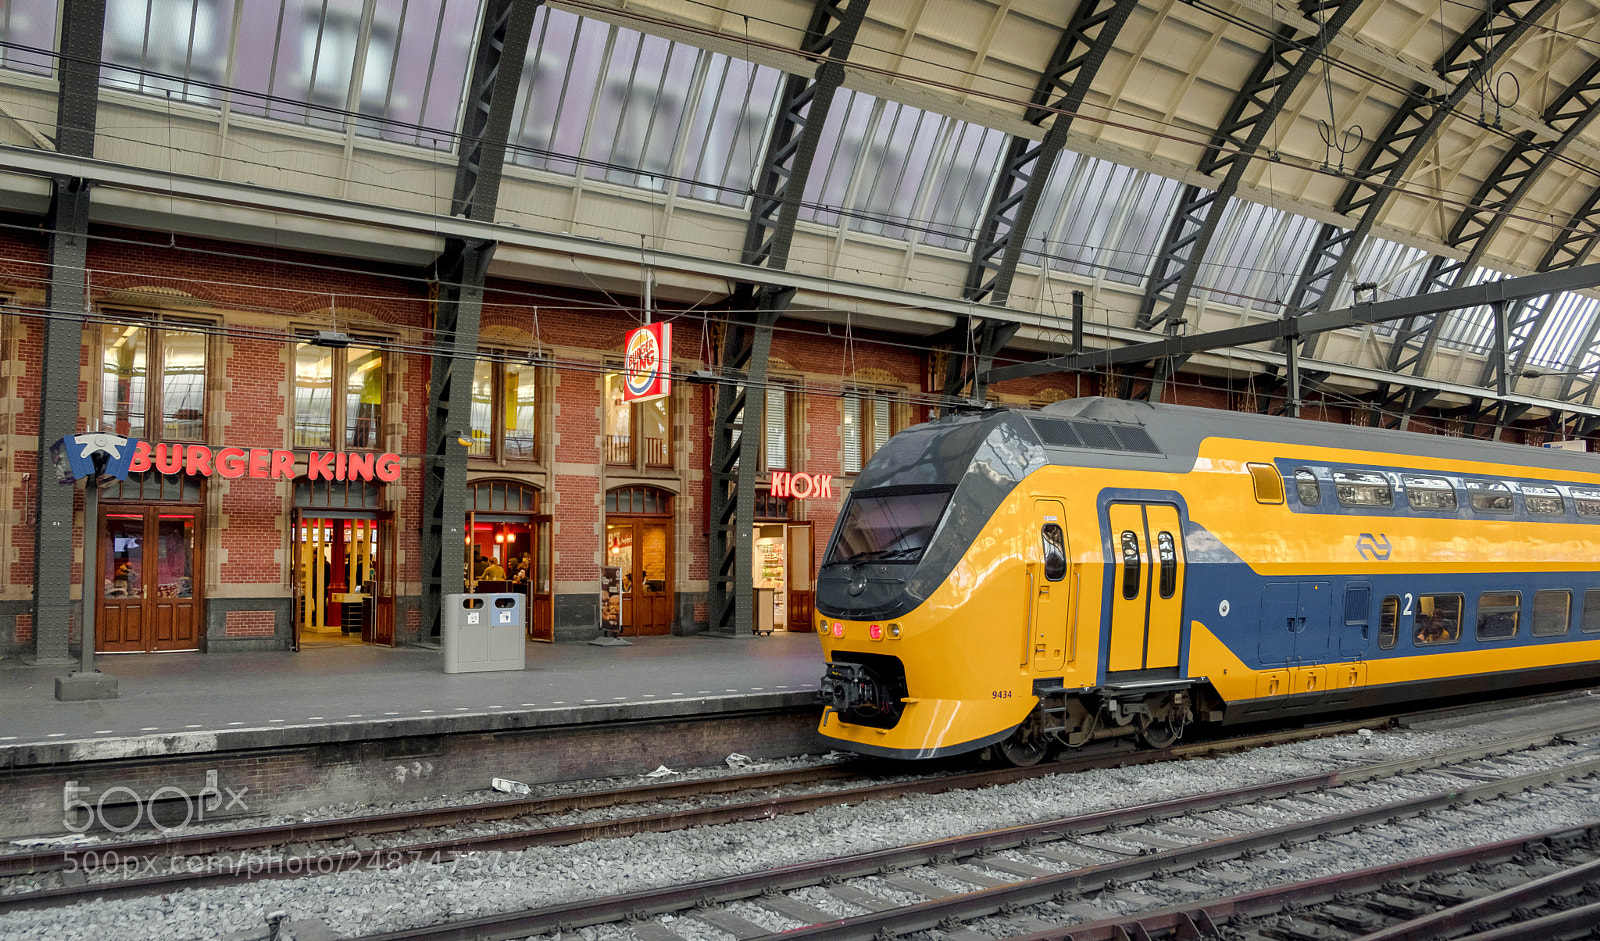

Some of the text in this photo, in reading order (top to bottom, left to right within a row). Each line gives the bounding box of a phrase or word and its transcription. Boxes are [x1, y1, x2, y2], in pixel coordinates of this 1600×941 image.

[628, 338, 654, 368] BURGER
[628, 350, 655, 384] KING
[128, 441, 401, 482] BURGER KING
[771, 471, 832, 499] KIOSK
[1402, 592, 1413, 616] 2
[992, 690, 1012, 699] 9434
